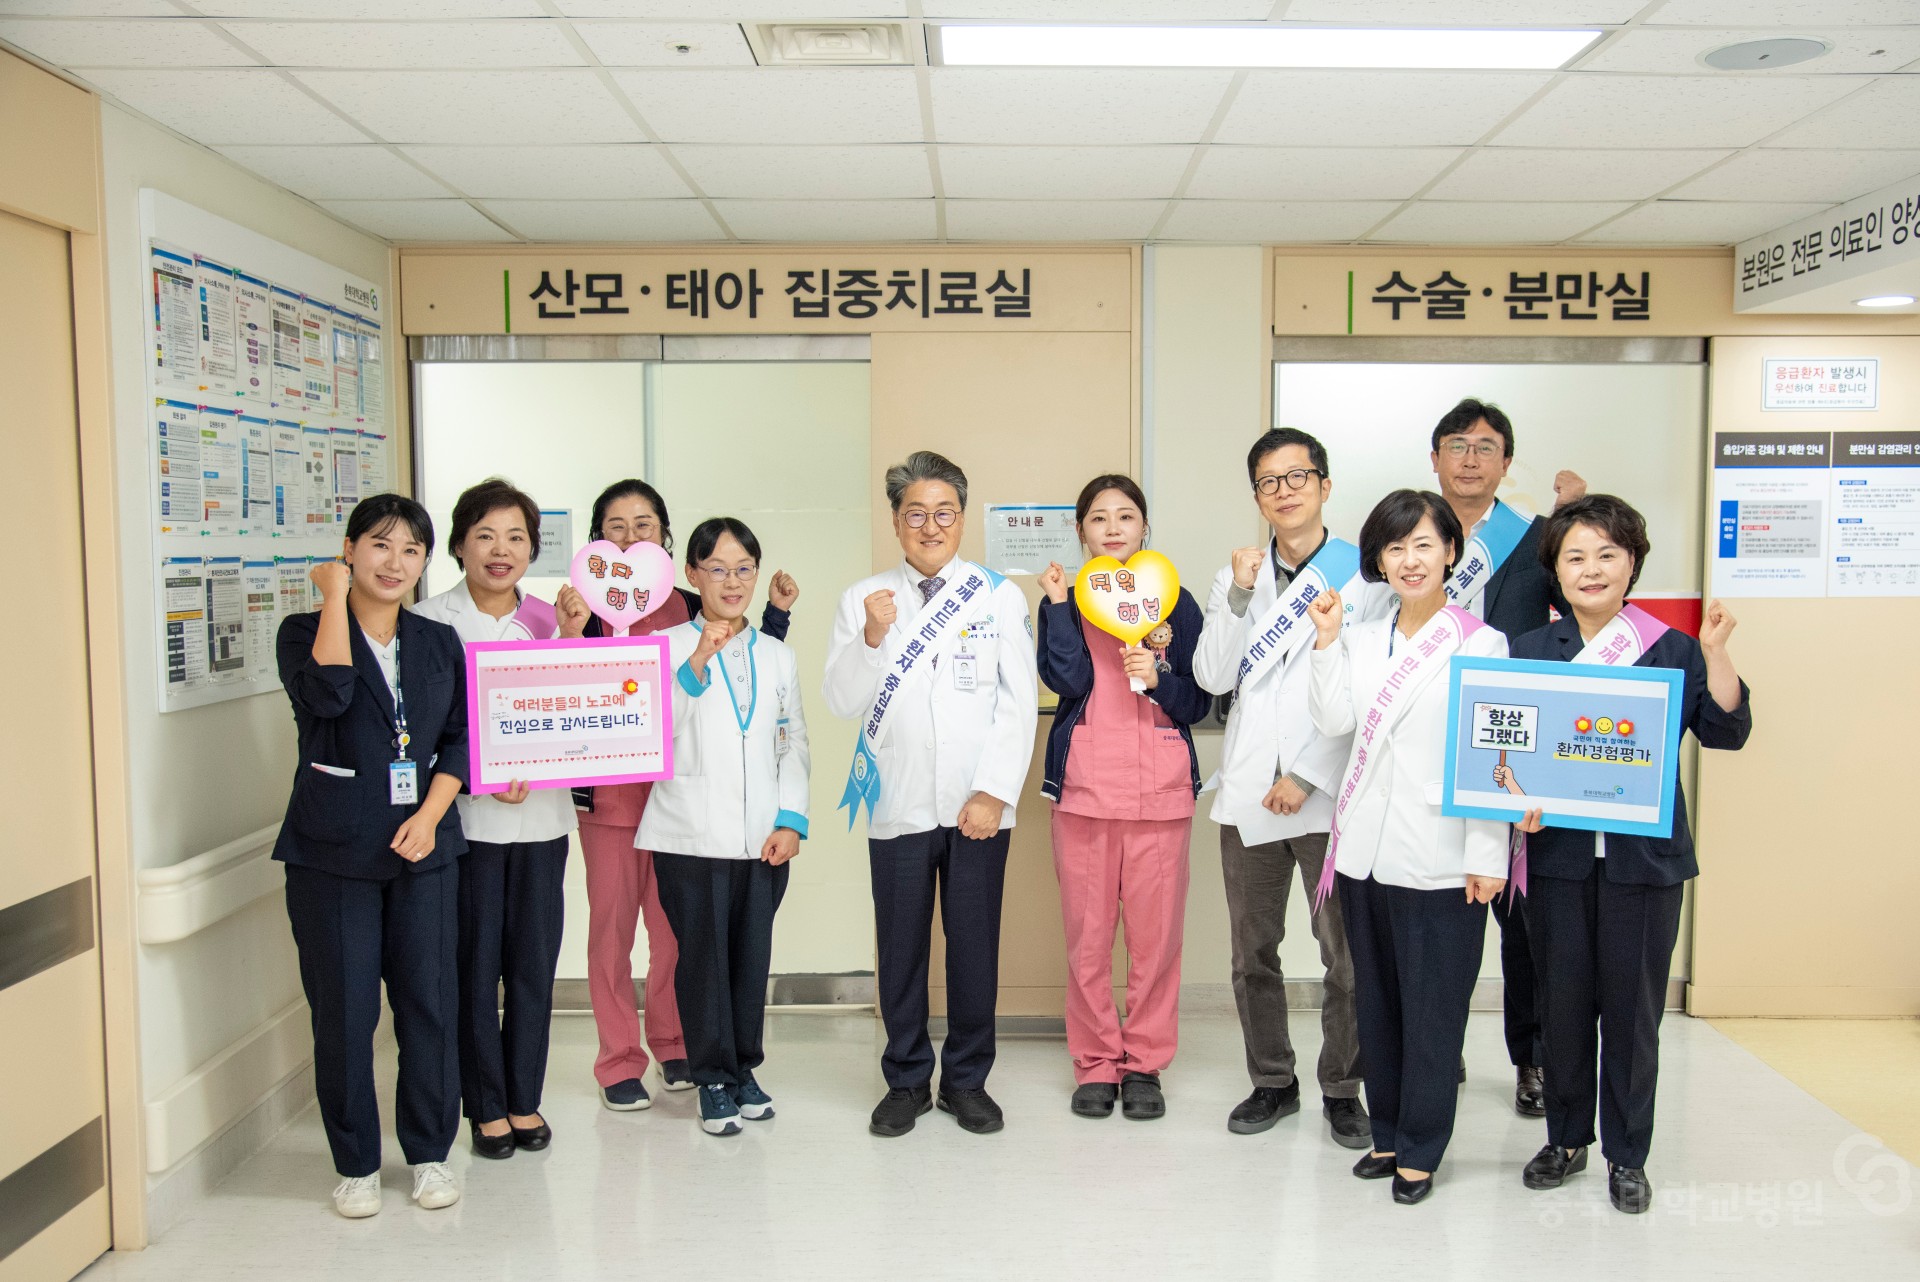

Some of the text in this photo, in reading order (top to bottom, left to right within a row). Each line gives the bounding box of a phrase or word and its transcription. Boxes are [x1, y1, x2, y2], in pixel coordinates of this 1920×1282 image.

[1742, 244, 1785, 293] 본원은
[1791, 230, 1823, 277] 전문
[1829, 207, 1884, 262] 의료인
[784, 268, 1032, 319] 집중치료실
[1775, 366, 1867, 380] 응급환자 발생시
[1775, 383, 1867, 394] 우선하여 진료합니다
[1723, 444, 1824, 456] 출입기준 강화 및 제한 안내
[1849, 444, 1876, 456] 분만실
[1877, 444, 1912, 456] 감염관리
[588, 554, 634, 579] 환자
[1455, 556, 1484, 590] 함께
[955, 574, 984, 603] 함께
[1089, 569, 1135, 592] 직원
[607, 587, 650, 612] 행복
[1117, 598, 1160, 624] 행복
[1290, 583, 1320, 619] 함께
[919, 598, 961, 642] 만드는
[1249, 614, 1294, 661] 만드는
[1417, 626, 1452, 659] 함께
[1598, 632, 1632, 665] 함께
[895, 639, 926, 674] 환자
[1376, 656, 1420, 708] 만드는
[513, 693, 626, 712] 여러분들의 노고에
[500, 713, 644, 735] 진심으로 감사드립니다.
[1362, 707, 1383, 746] 환자
[1489, 709, 1524, 728] 항상
[1479, 728, 1530, 746] 그랬다
[1594, 736, 1608, 744] 직접
[1610, 737, 1636, 747] 참여하는
[1556, 741, 1651, 763] 환자경험평가
